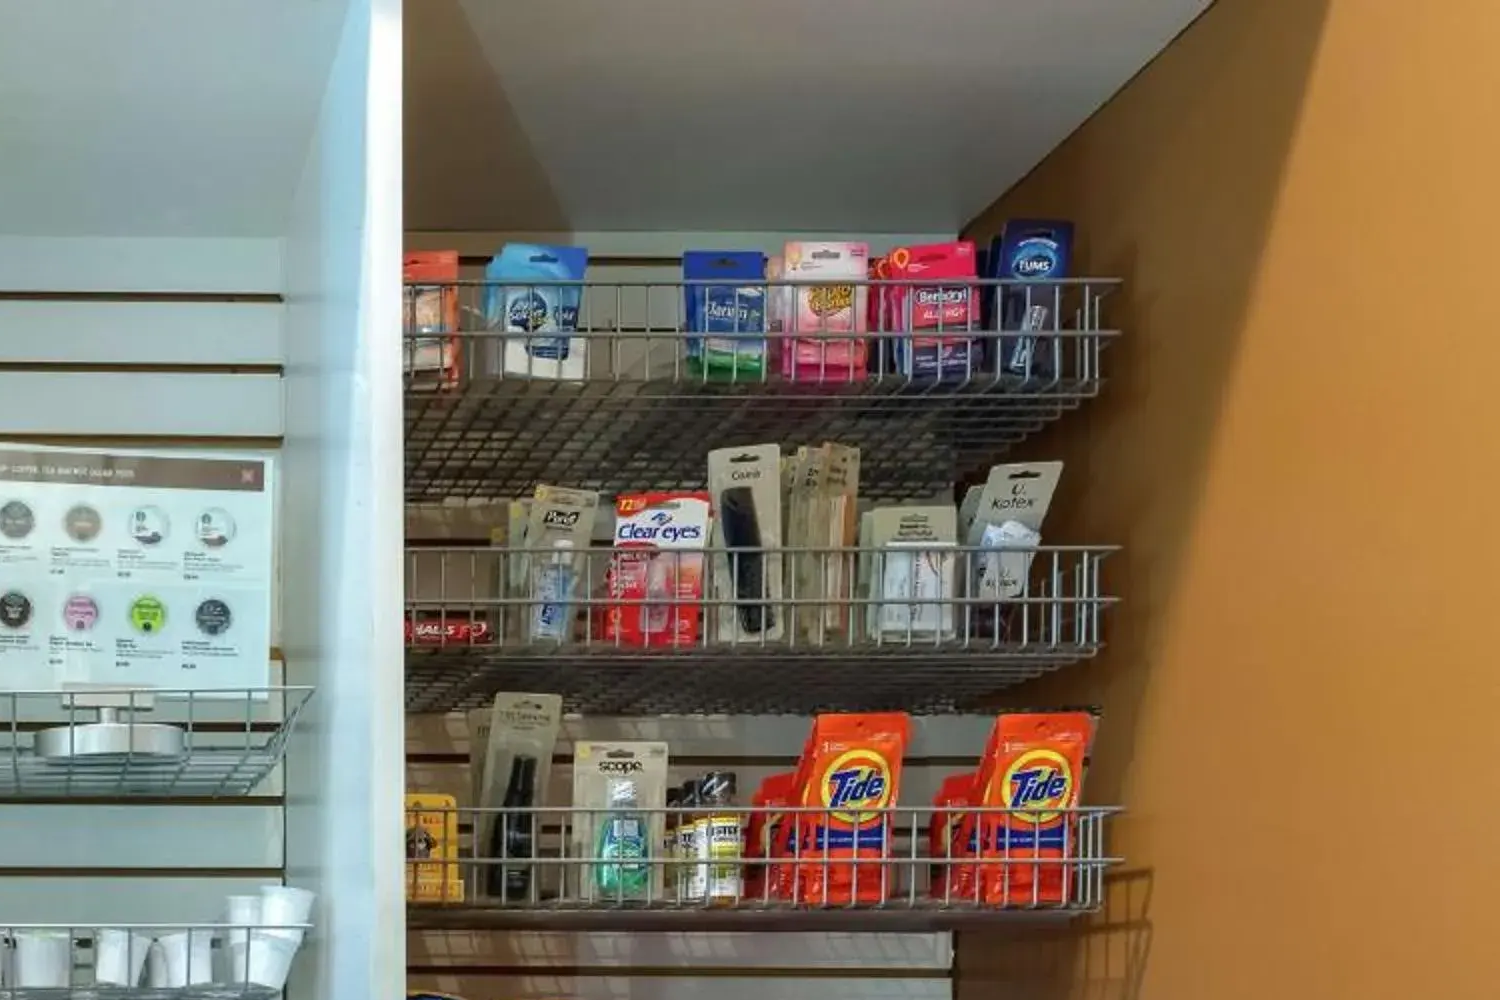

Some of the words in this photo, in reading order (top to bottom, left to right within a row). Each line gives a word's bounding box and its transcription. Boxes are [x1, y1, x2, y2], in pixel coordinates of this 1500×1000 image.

[1017, 259, 1052, 273] TUMS
[617, 523, 659, 540] Clear
[662, 525, 701, 543] eyes
[598, 758, 643, 775] scope
[829, 768, 885, 809] Tide
[1010, 768, 1067, 809] Tide
